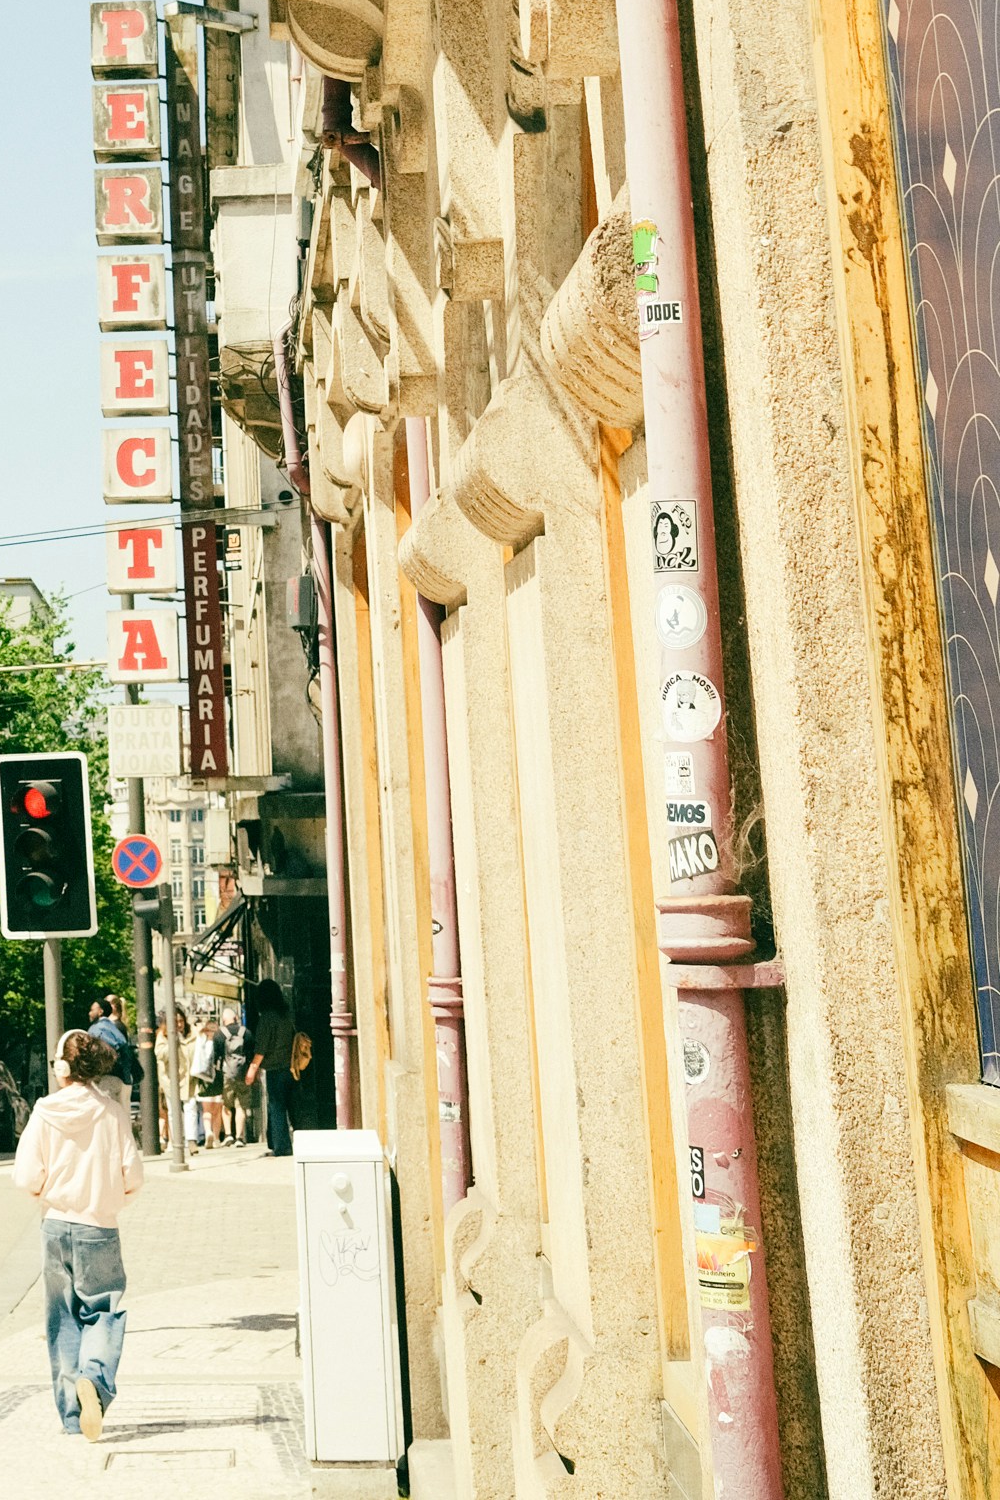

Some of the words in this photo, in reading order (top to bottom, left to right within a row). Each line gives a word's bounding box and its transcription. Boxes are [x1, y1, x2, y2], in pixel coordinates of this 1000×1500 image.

[101, 9, 168, 671] PERFECTA
[181, 267, 205, 501] UTILIDADES
[191, 527, 218, 771] PERFUMARIA
[113, 710, 173, 728] OURO
[114, 732, 174, 750] PRATA
[115, 754, 174, 772] JOIAS
